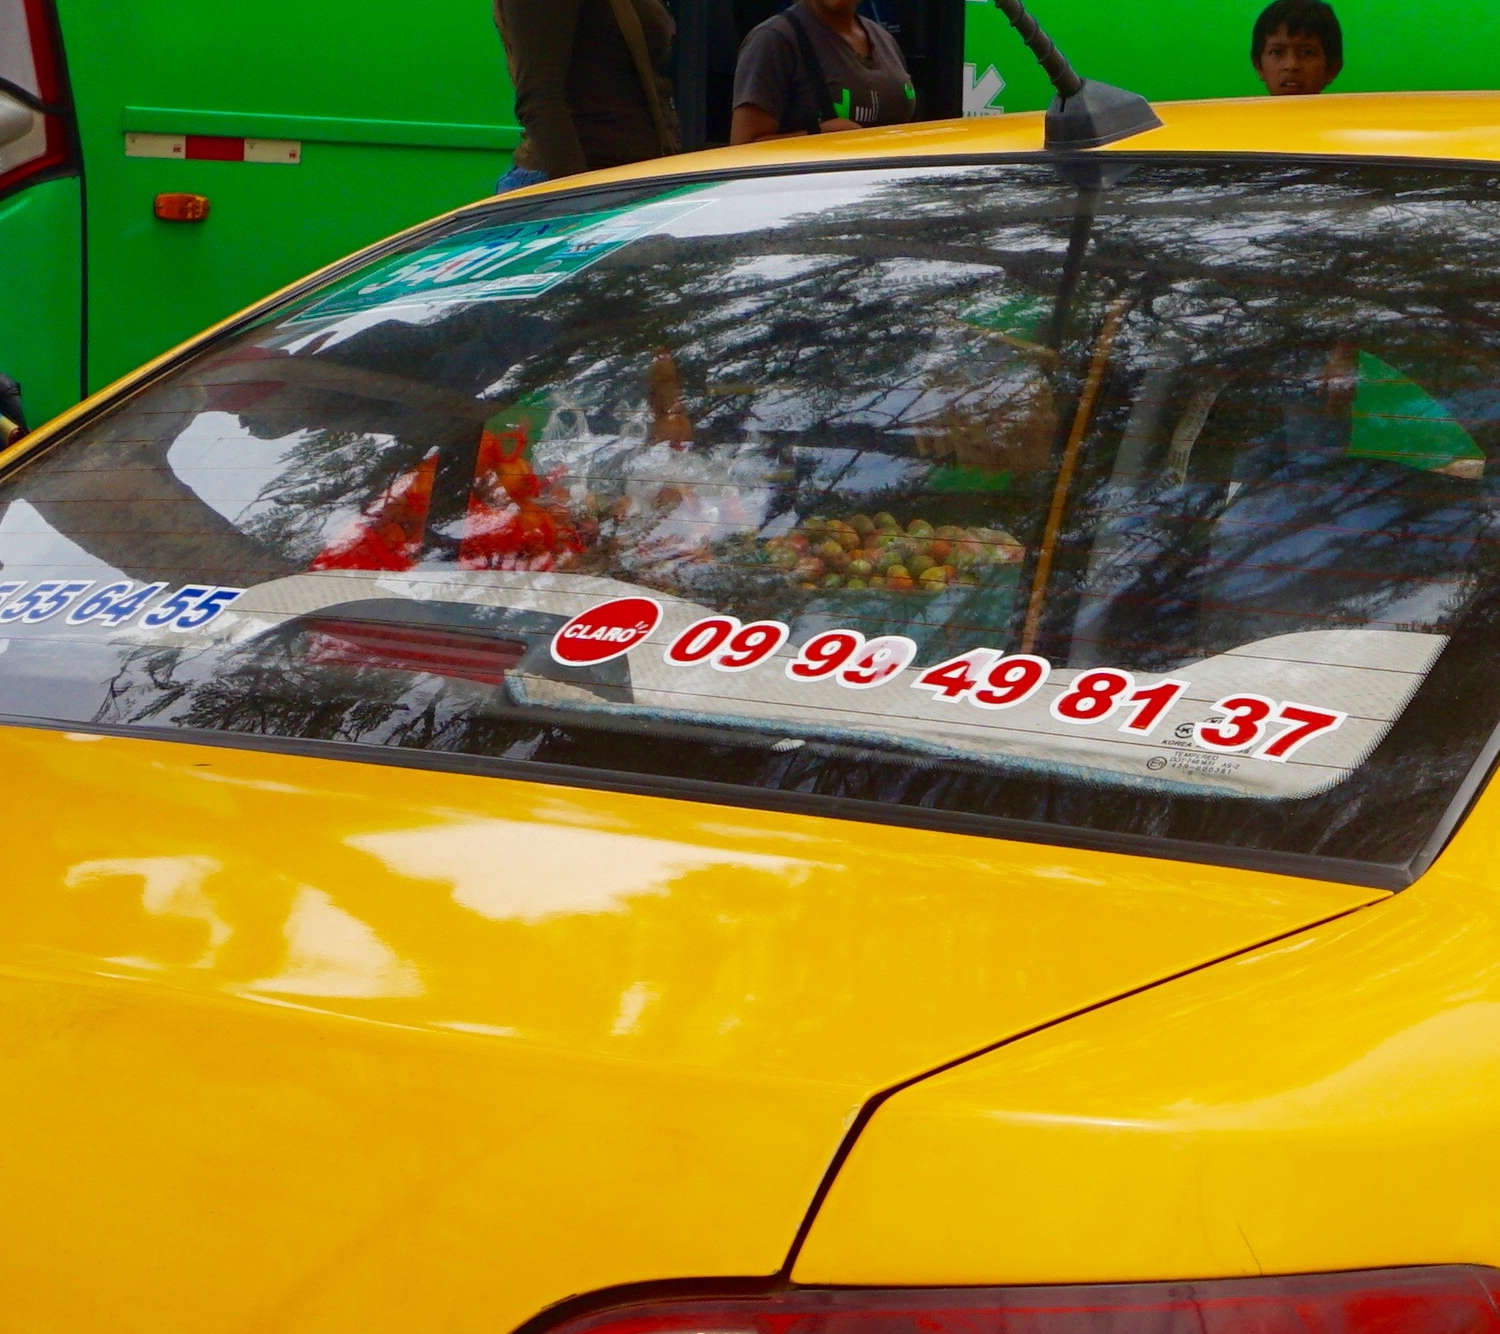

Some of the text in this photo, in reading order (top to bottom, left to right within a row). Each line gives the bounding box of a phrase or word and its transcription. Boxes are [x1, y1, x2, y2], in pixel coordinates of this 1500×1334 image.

[0, 581, 95, 623] 55
[71, 583, 160, 627] 64
[145, 586, 244, 630] 55
[563, 620, 635, 646] CLARO
[670, 621, 1342, 762] 09 99 49 81 37
